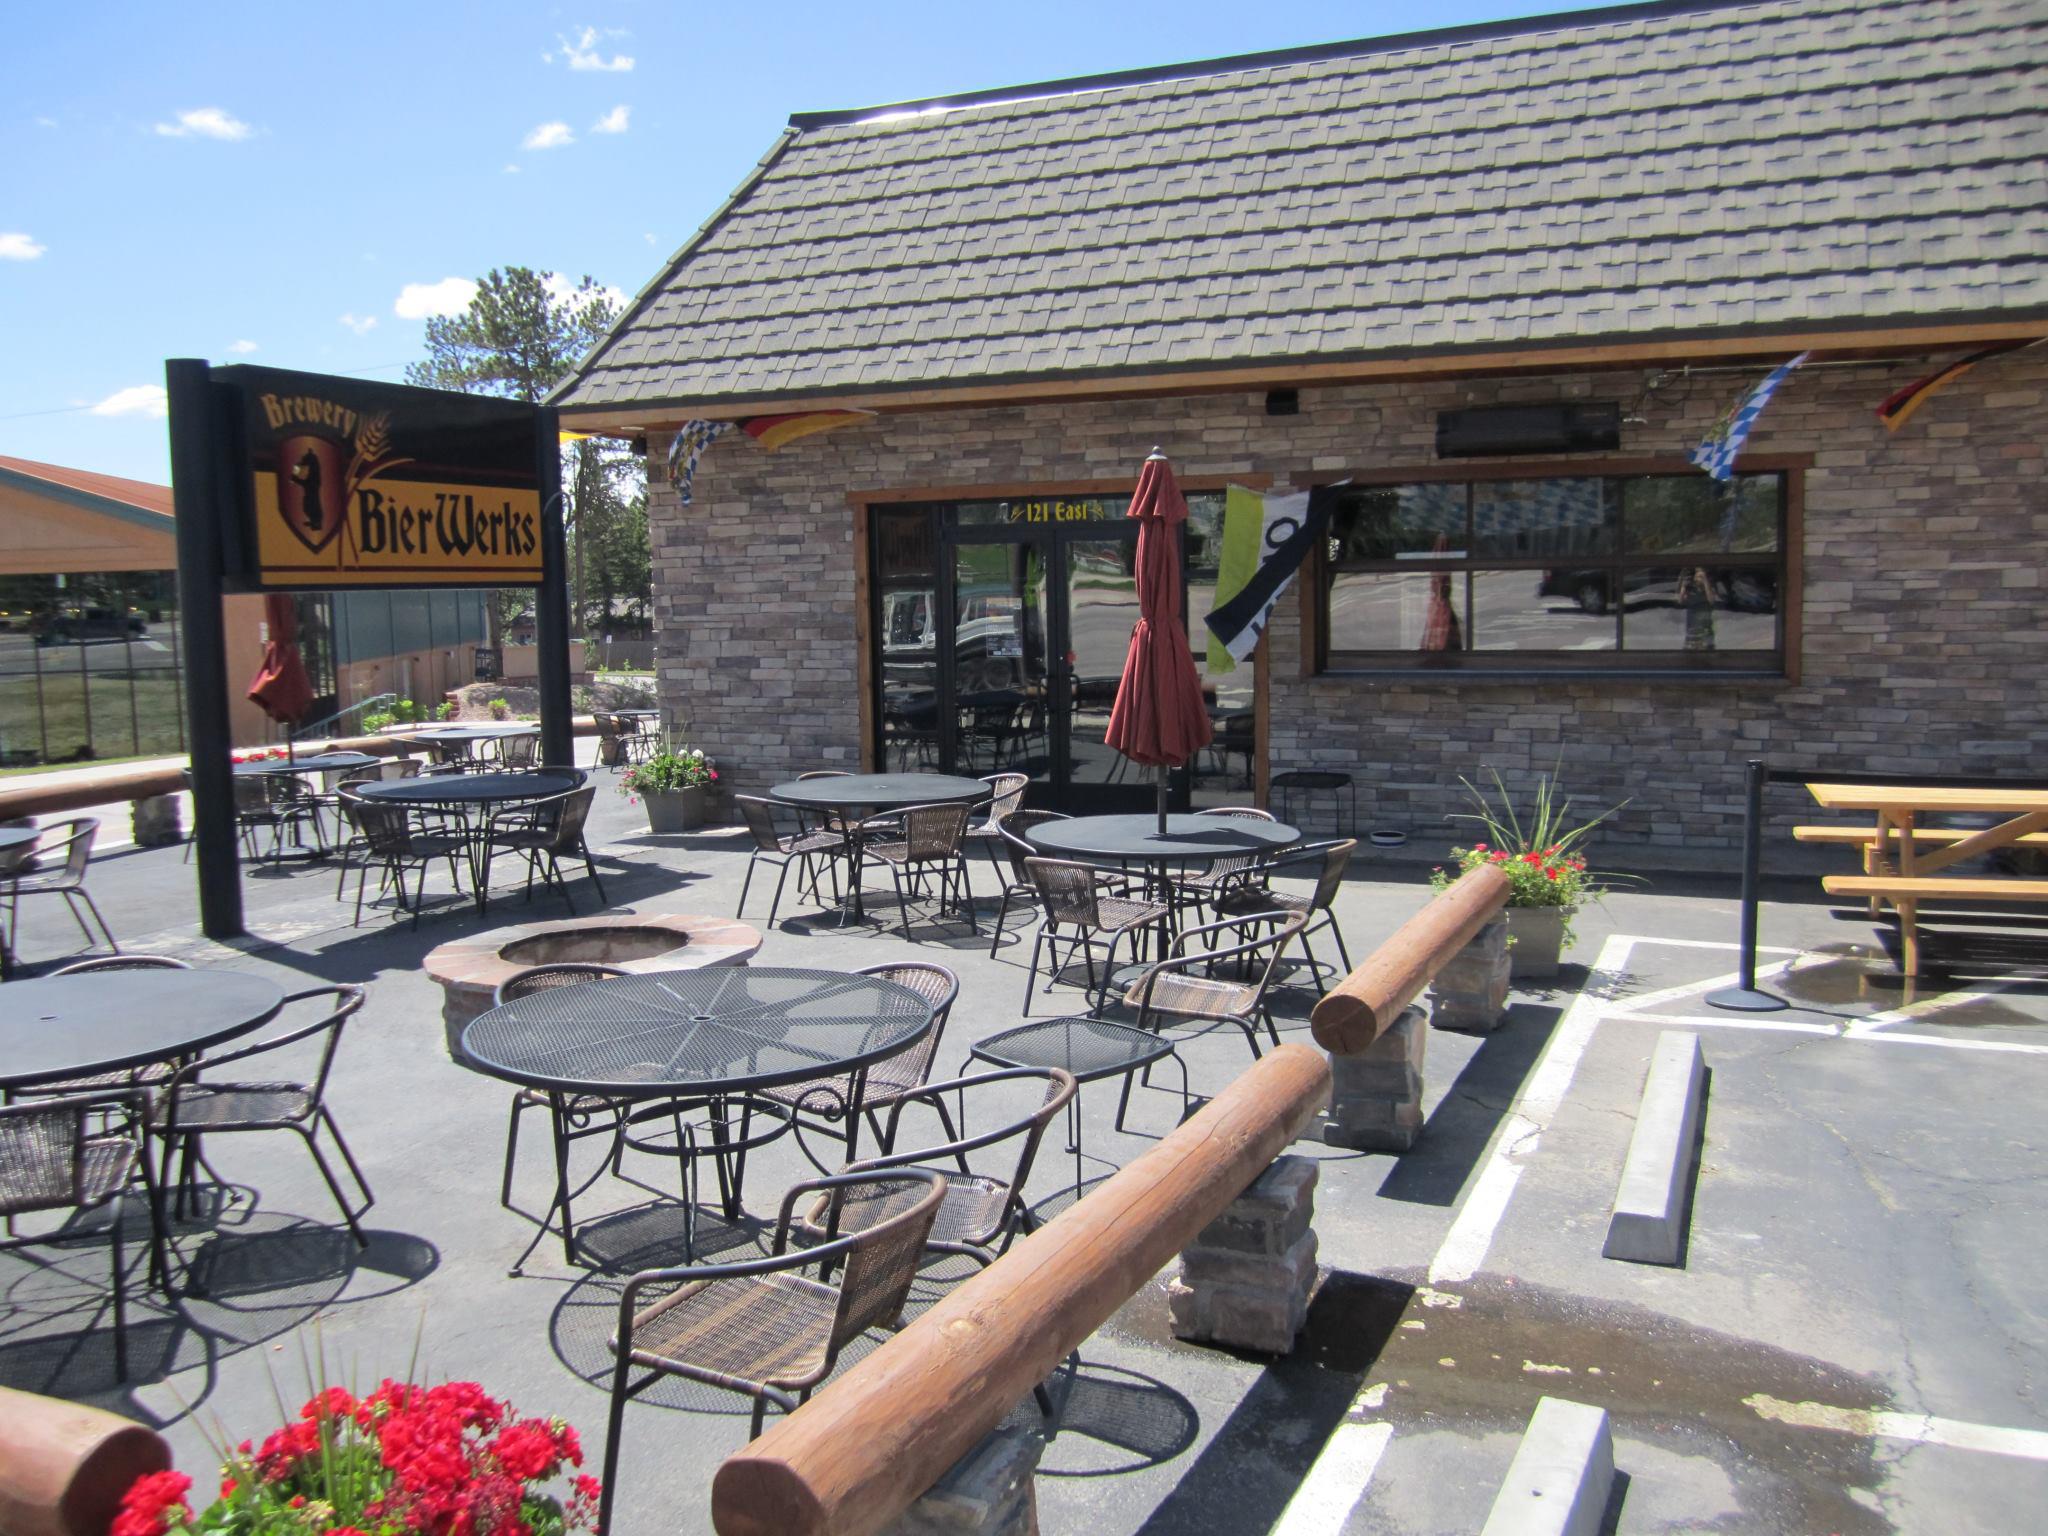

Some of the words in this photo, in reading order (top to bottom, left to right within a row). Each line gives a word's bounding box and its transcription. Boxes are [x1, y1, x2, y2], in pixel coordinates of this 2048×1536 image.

[261, 393, 356, 439] Brewery
[356, 488, 536, 556] BierWerks
[1026, 503, 1049, 523] 121
[1054, 502, 1088, 521] East
